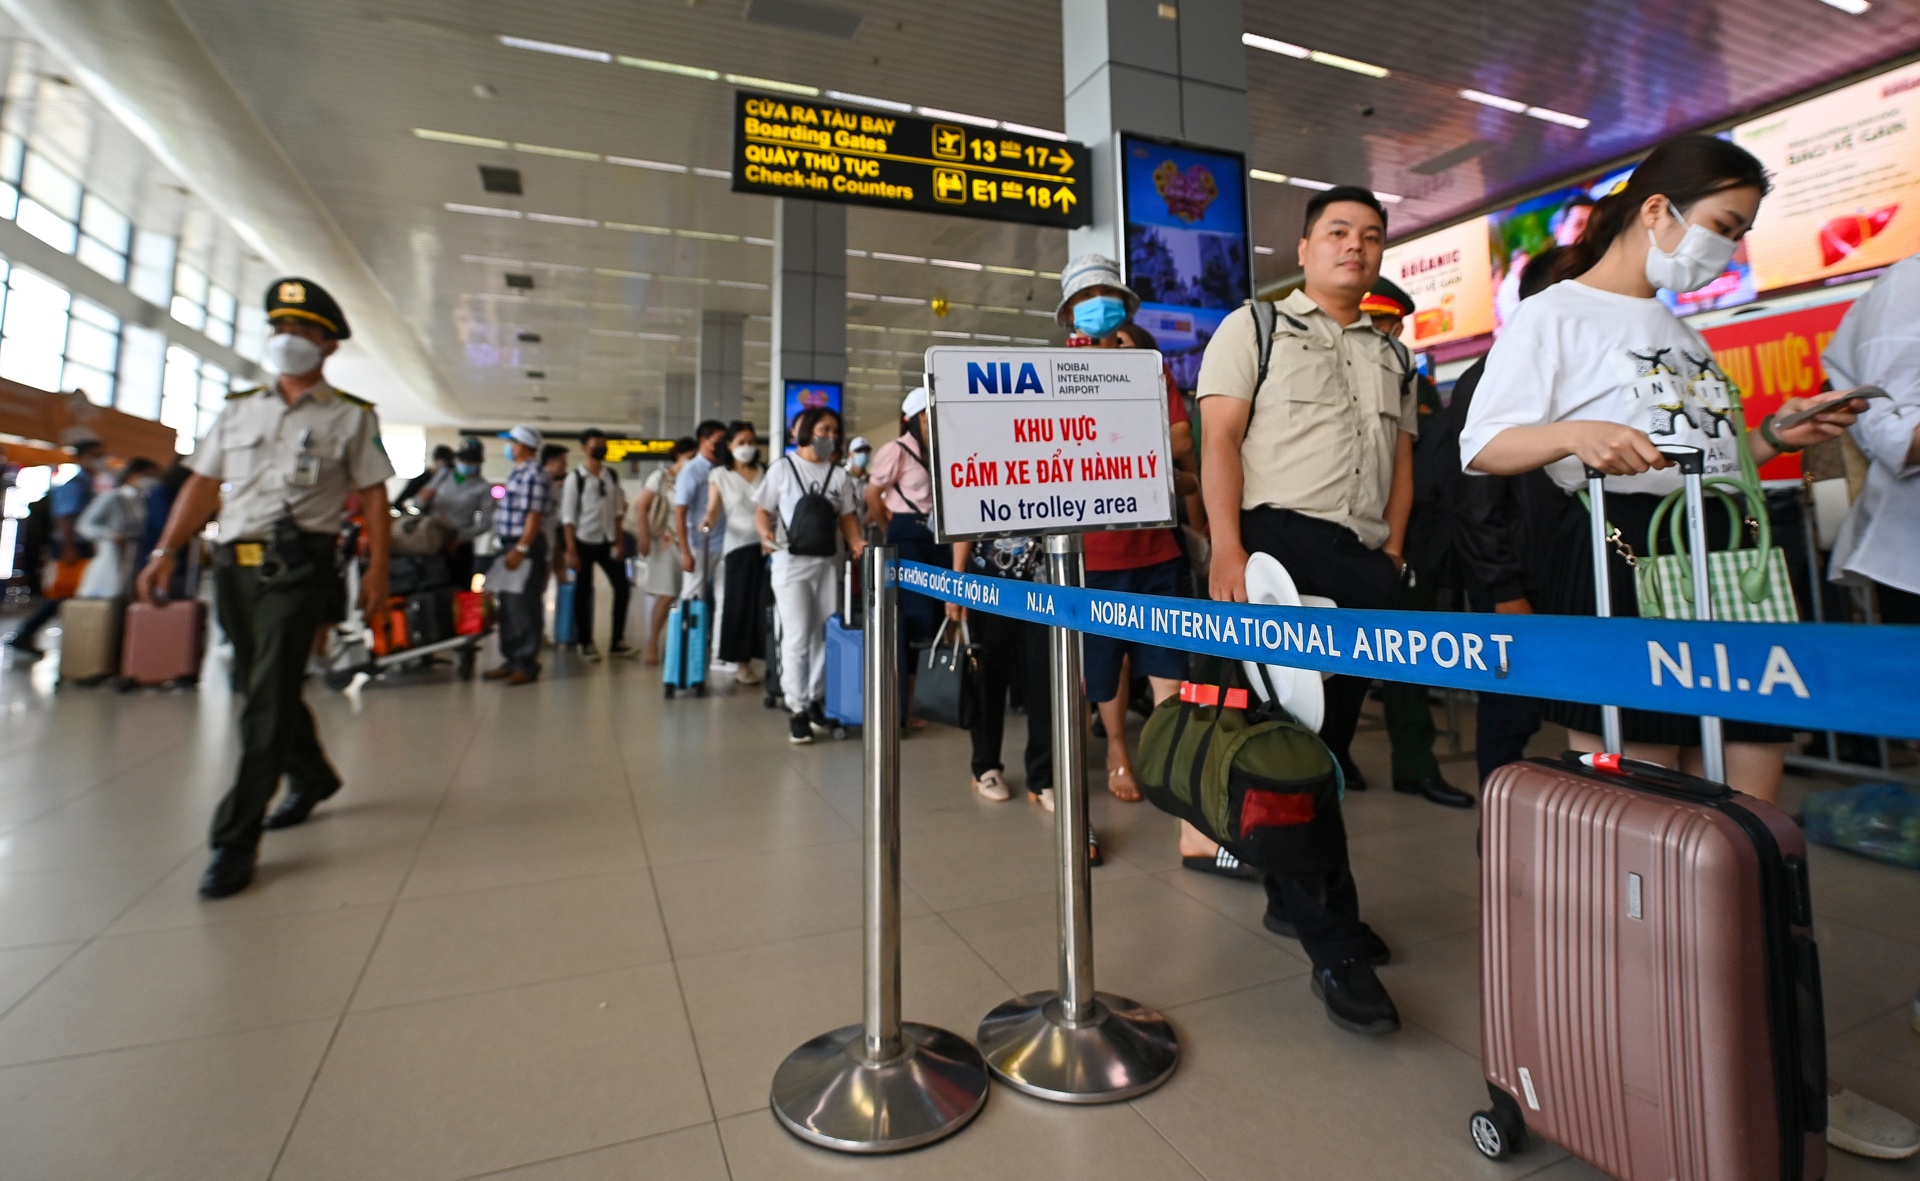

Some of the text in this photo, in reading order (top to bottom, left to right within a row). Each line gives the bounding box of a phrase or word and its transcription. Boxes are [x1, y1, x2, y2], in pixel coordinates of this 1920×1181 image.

[745, 117, 887, 153] Boarding Gates
[791, 105, 819, 125] RA
[861, 115, 896, 135] BAY
[843, 157, 880, 179] TỤC
[970, 138, 997, 163] 13
[1024, 145, 1049, 169] 17
[745, 164, 914, 201] Check-in Counters
[972, 178, 997, 203] E1
[1025, 185, 1051, 209] 18
[967, 362, 1044, 394] NIA
[1057, 363, 1089, 372] NOIBAI
[1058, 373, 1131, 383] INTERNATIONAL
[1059, 385, 1100, 394] AIRPORT
[1014, 415, 1097, 446] KHU VỰC
[950, 448, 1158, 488] CẤM XE ĐẨY HÀNH LÝ
[980, 495, 1138, 522] No trolley area
[904, 567, 928, 587] KHÔNG
[929, 571, 951, 594] QUỐC
[953, 575, 965, 597] TẾ
[965, 579, 981, 605] NỘI
[982, 583, 999, 606] BÀI
[1027, 591, 1055, 616] N.I.A
[1090, 600, 1514, 674] NOIBAI INTERNATIONAL AIRPORT
[1647, 640, 1811, 699] N.I.A
